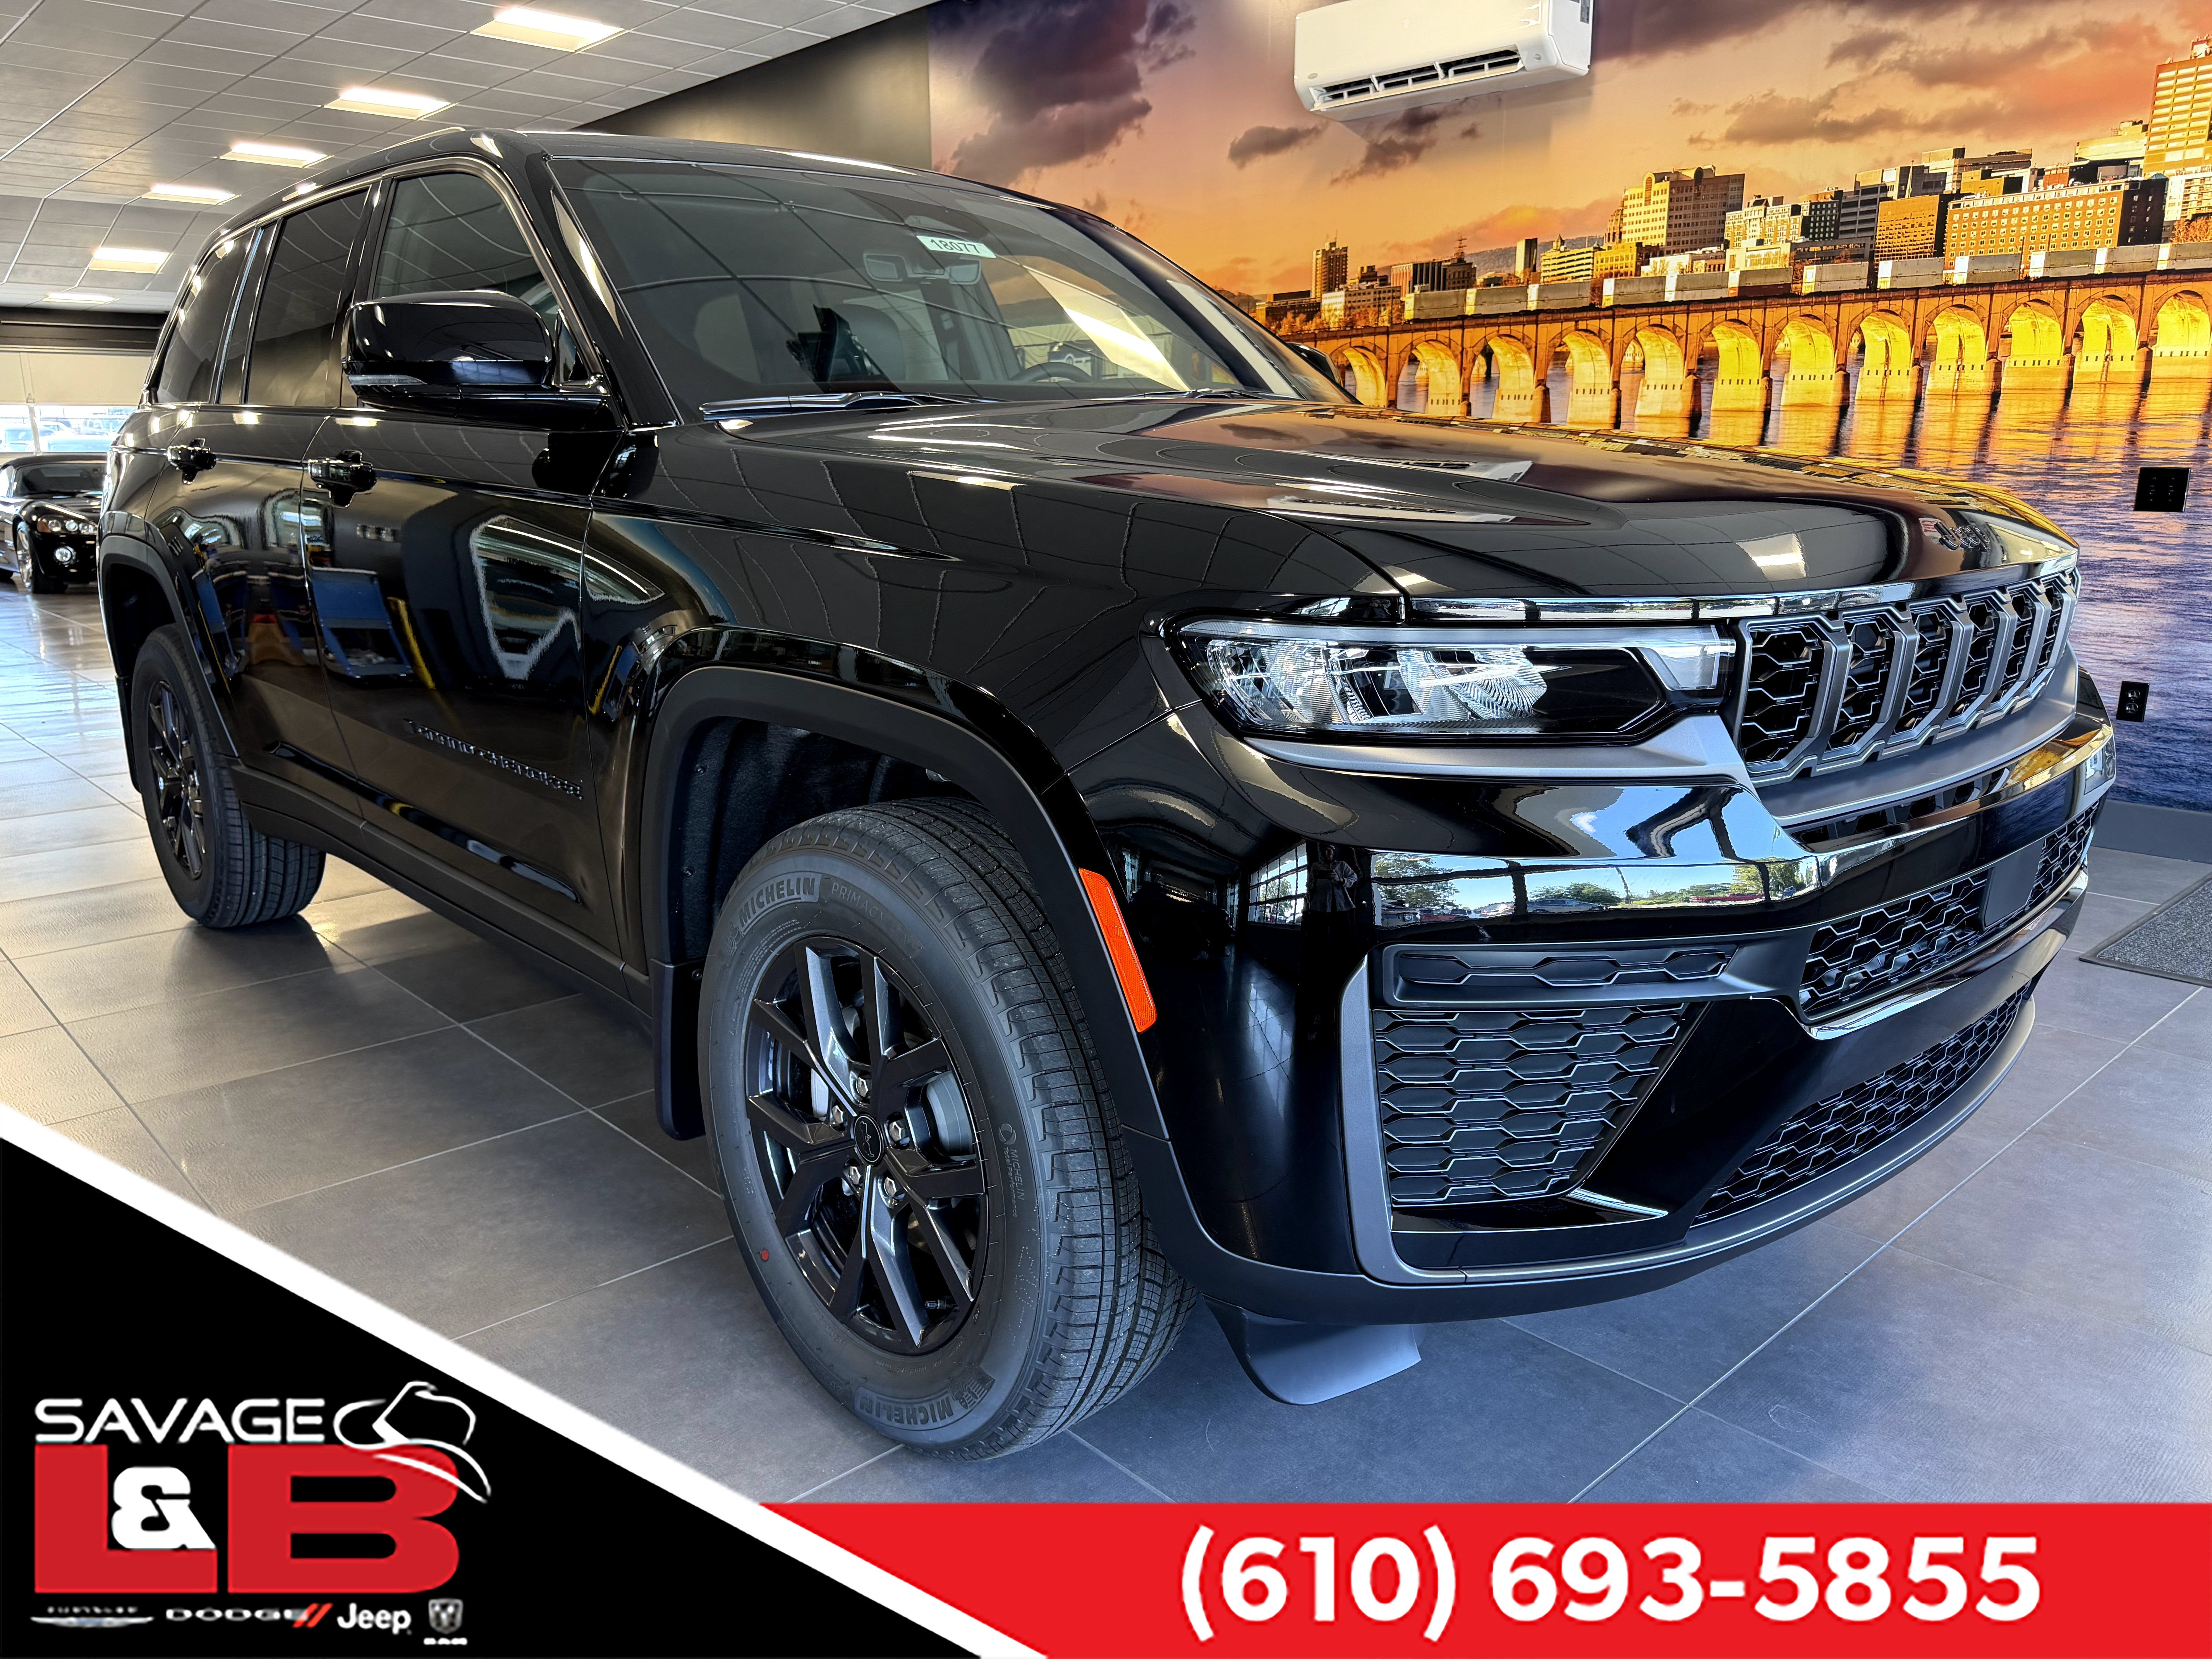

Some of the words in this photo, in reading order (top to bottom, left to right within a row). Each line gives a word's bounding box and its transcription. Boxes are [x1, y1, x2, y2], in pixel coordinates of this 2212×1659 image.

[931, 239, 980, 254] 18077
[738, 877, 816, 927] MICHELIN
[1010, 1149, 1025, 1200] MICHELIN
[860, 1396, 954, 1425] MICHELIN
